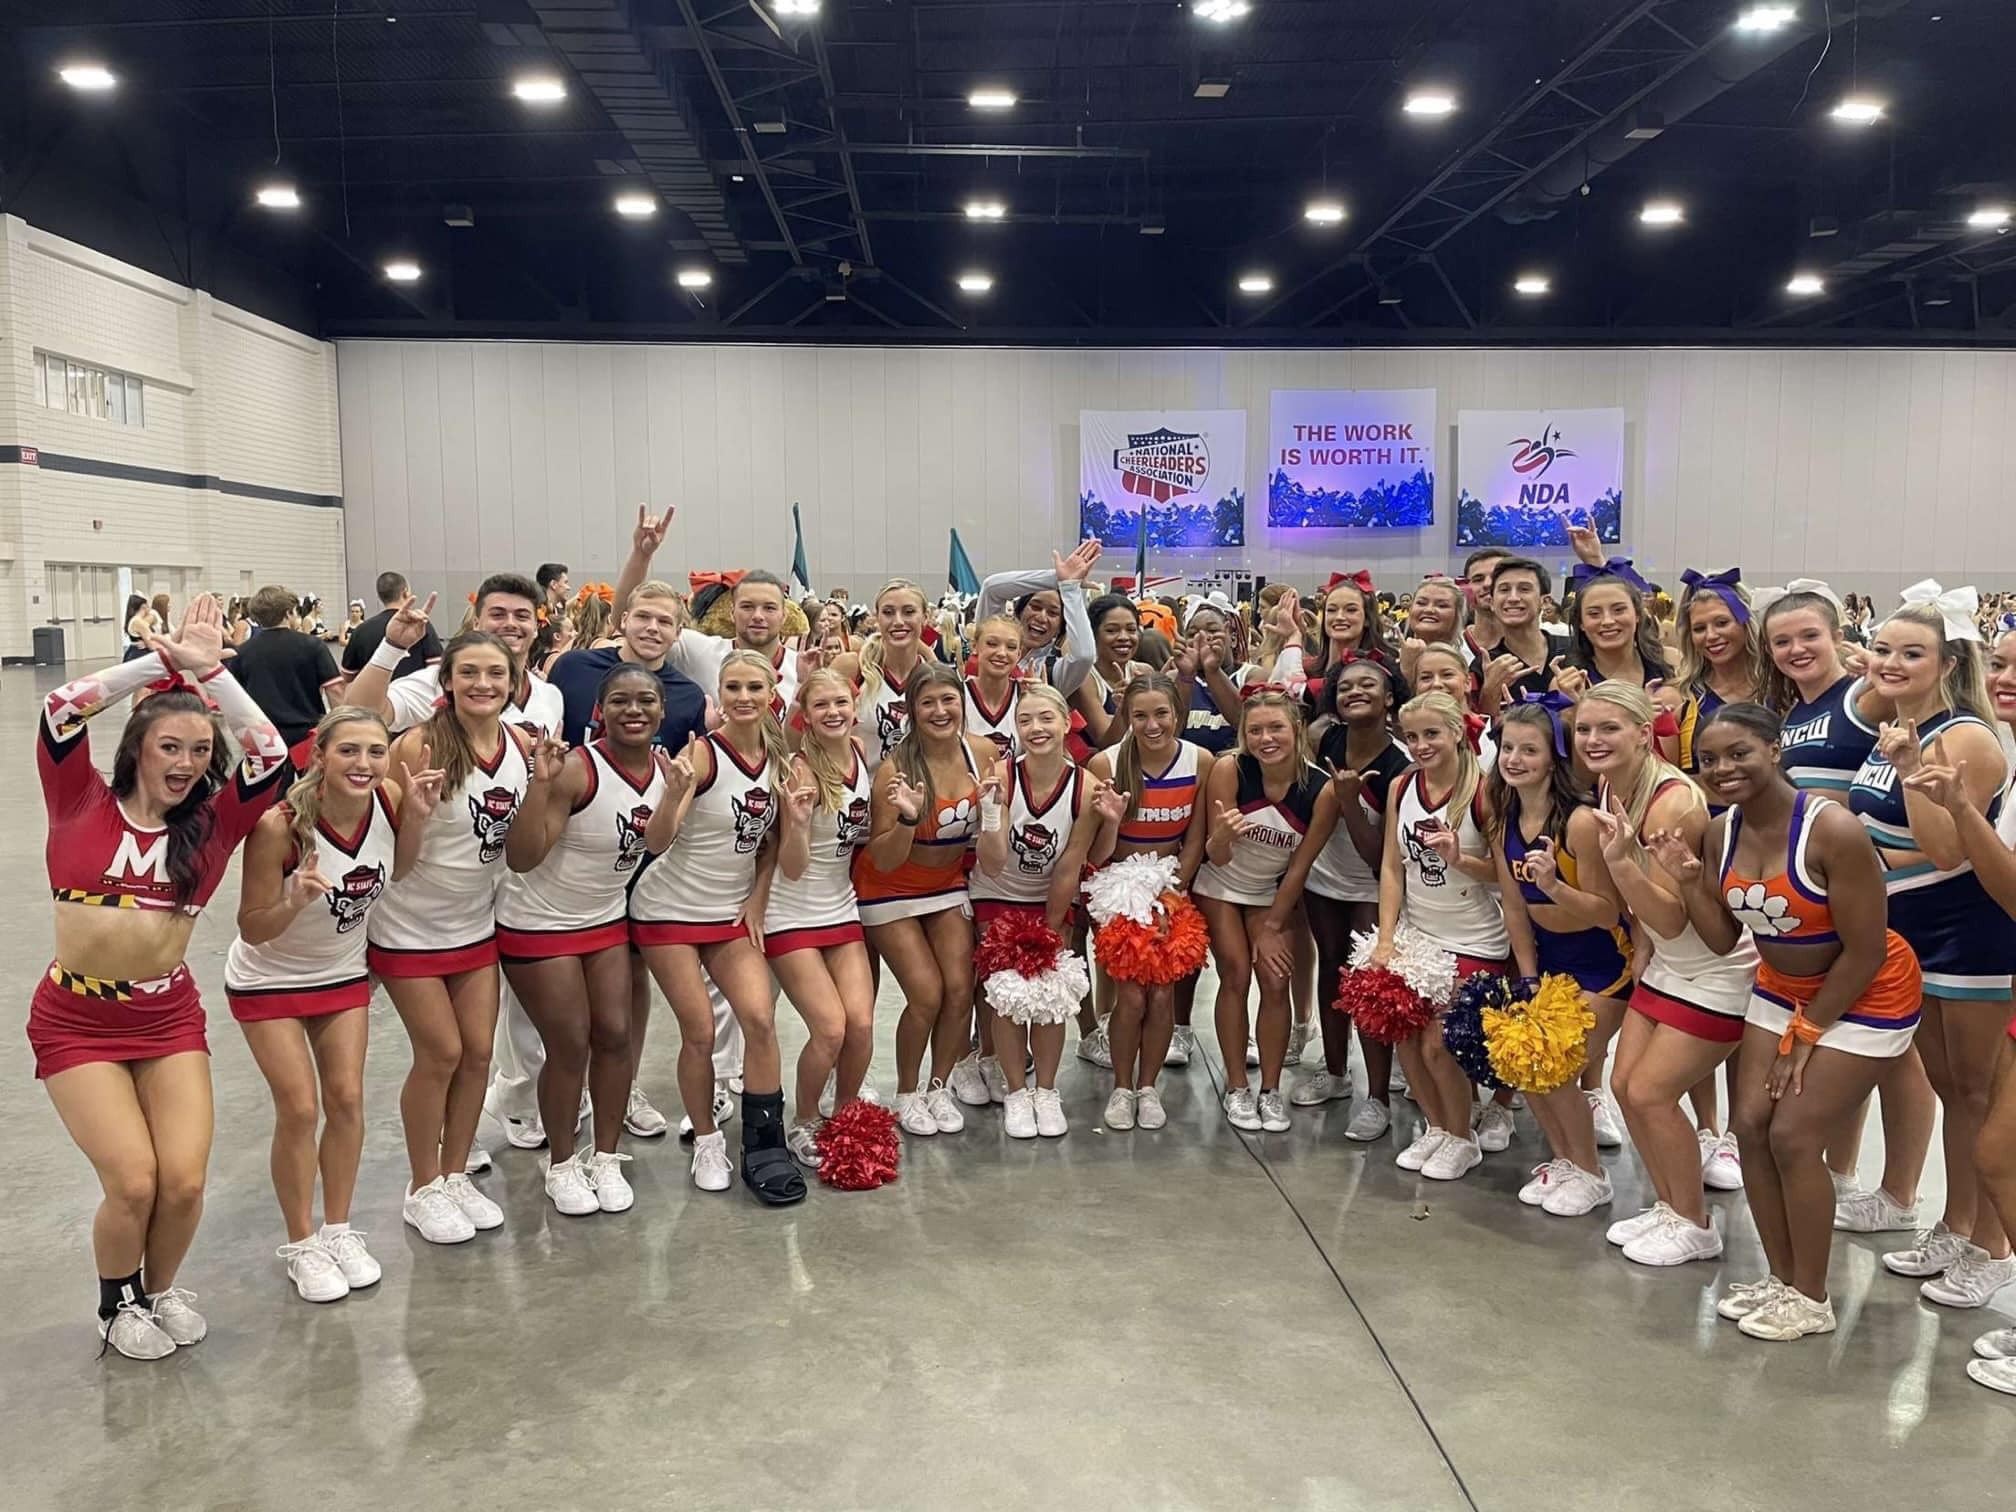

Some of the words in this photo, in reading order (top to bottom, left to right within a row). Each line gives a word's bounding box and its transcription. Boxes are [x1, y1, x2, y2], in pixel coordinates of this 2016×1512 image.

[1293, 425, 1337, 442] THE
[1344, 423, 1413, 441] WORK
[22, 451, 38, 461] EXIT
[1135, 442, 1194, 456] NATIONAL
[1281, 448, 1301, 465] IS
[1310, 448, 1392, 465] WORTH
[1400, 447, 1424, 464] IT.
[1119, 456, 1206, 475] CHEERLEADERS
[1129, 465, 1193, 487] ASSOCIATION
[1518, 483, 1570, 505] NDA
[1780, 715, 1832, 749] NCW
[1852, 761, 1897, 793] NCW
[1242, 825, 1294, 849] AROLINA
[103, 831, 172, 884] M
[1511, 859, 1538, 882] EC
